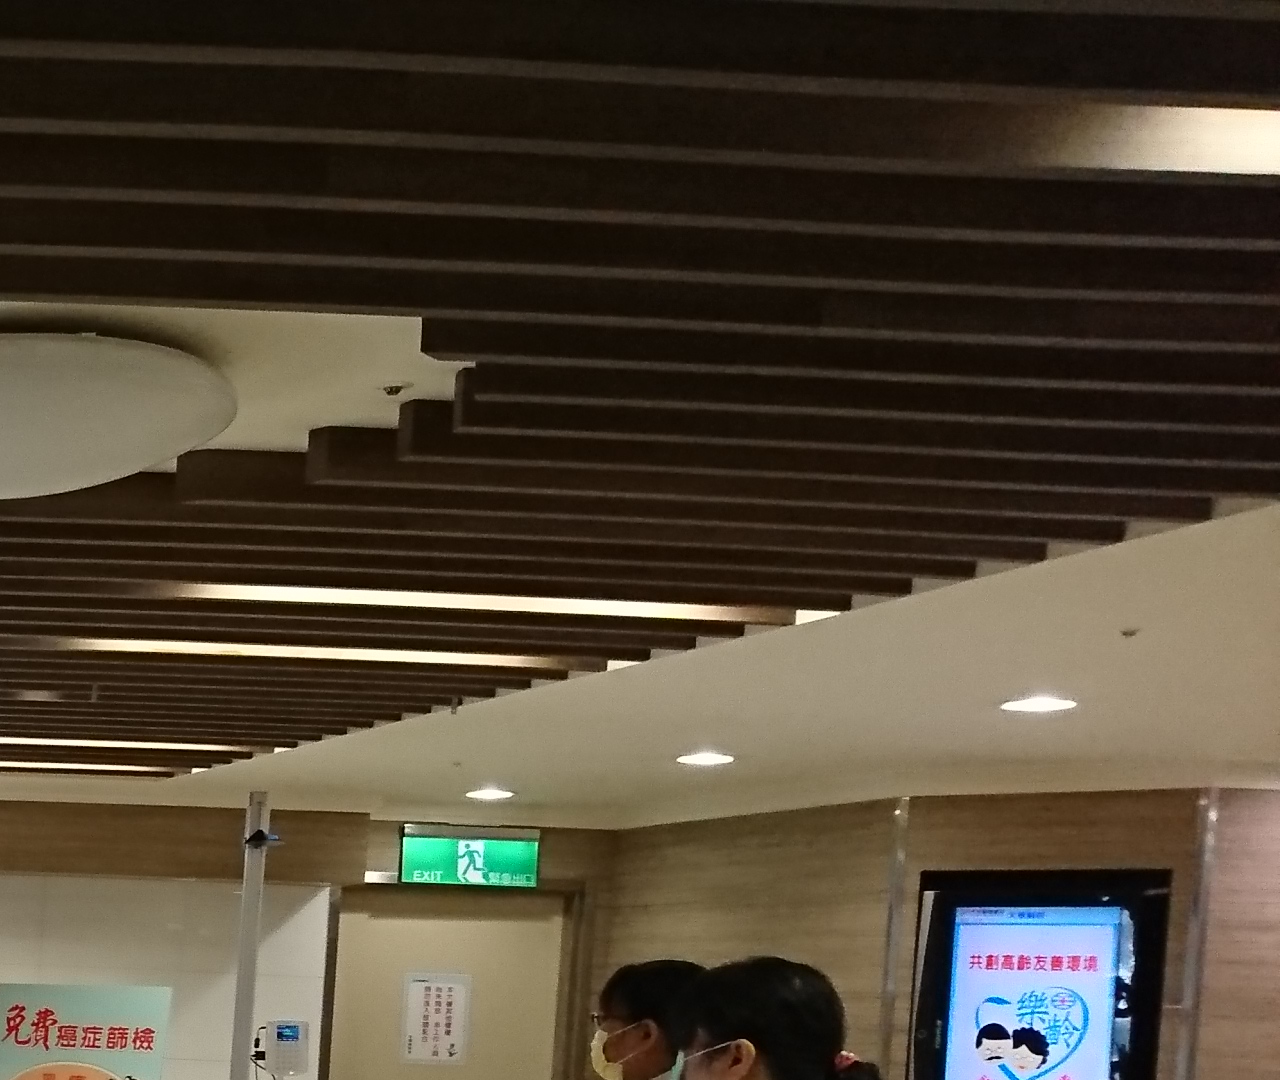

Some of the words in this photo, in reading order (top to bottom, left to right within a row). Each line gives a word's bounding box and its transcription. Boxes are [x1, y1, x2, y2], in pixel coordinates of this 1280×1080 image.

[413, 871, 443, 881] EXIT
[969, 954, 1099, 973] 共創高齡友善環境
[1, 1003, 156, 1052] 免費癌症篩檢
